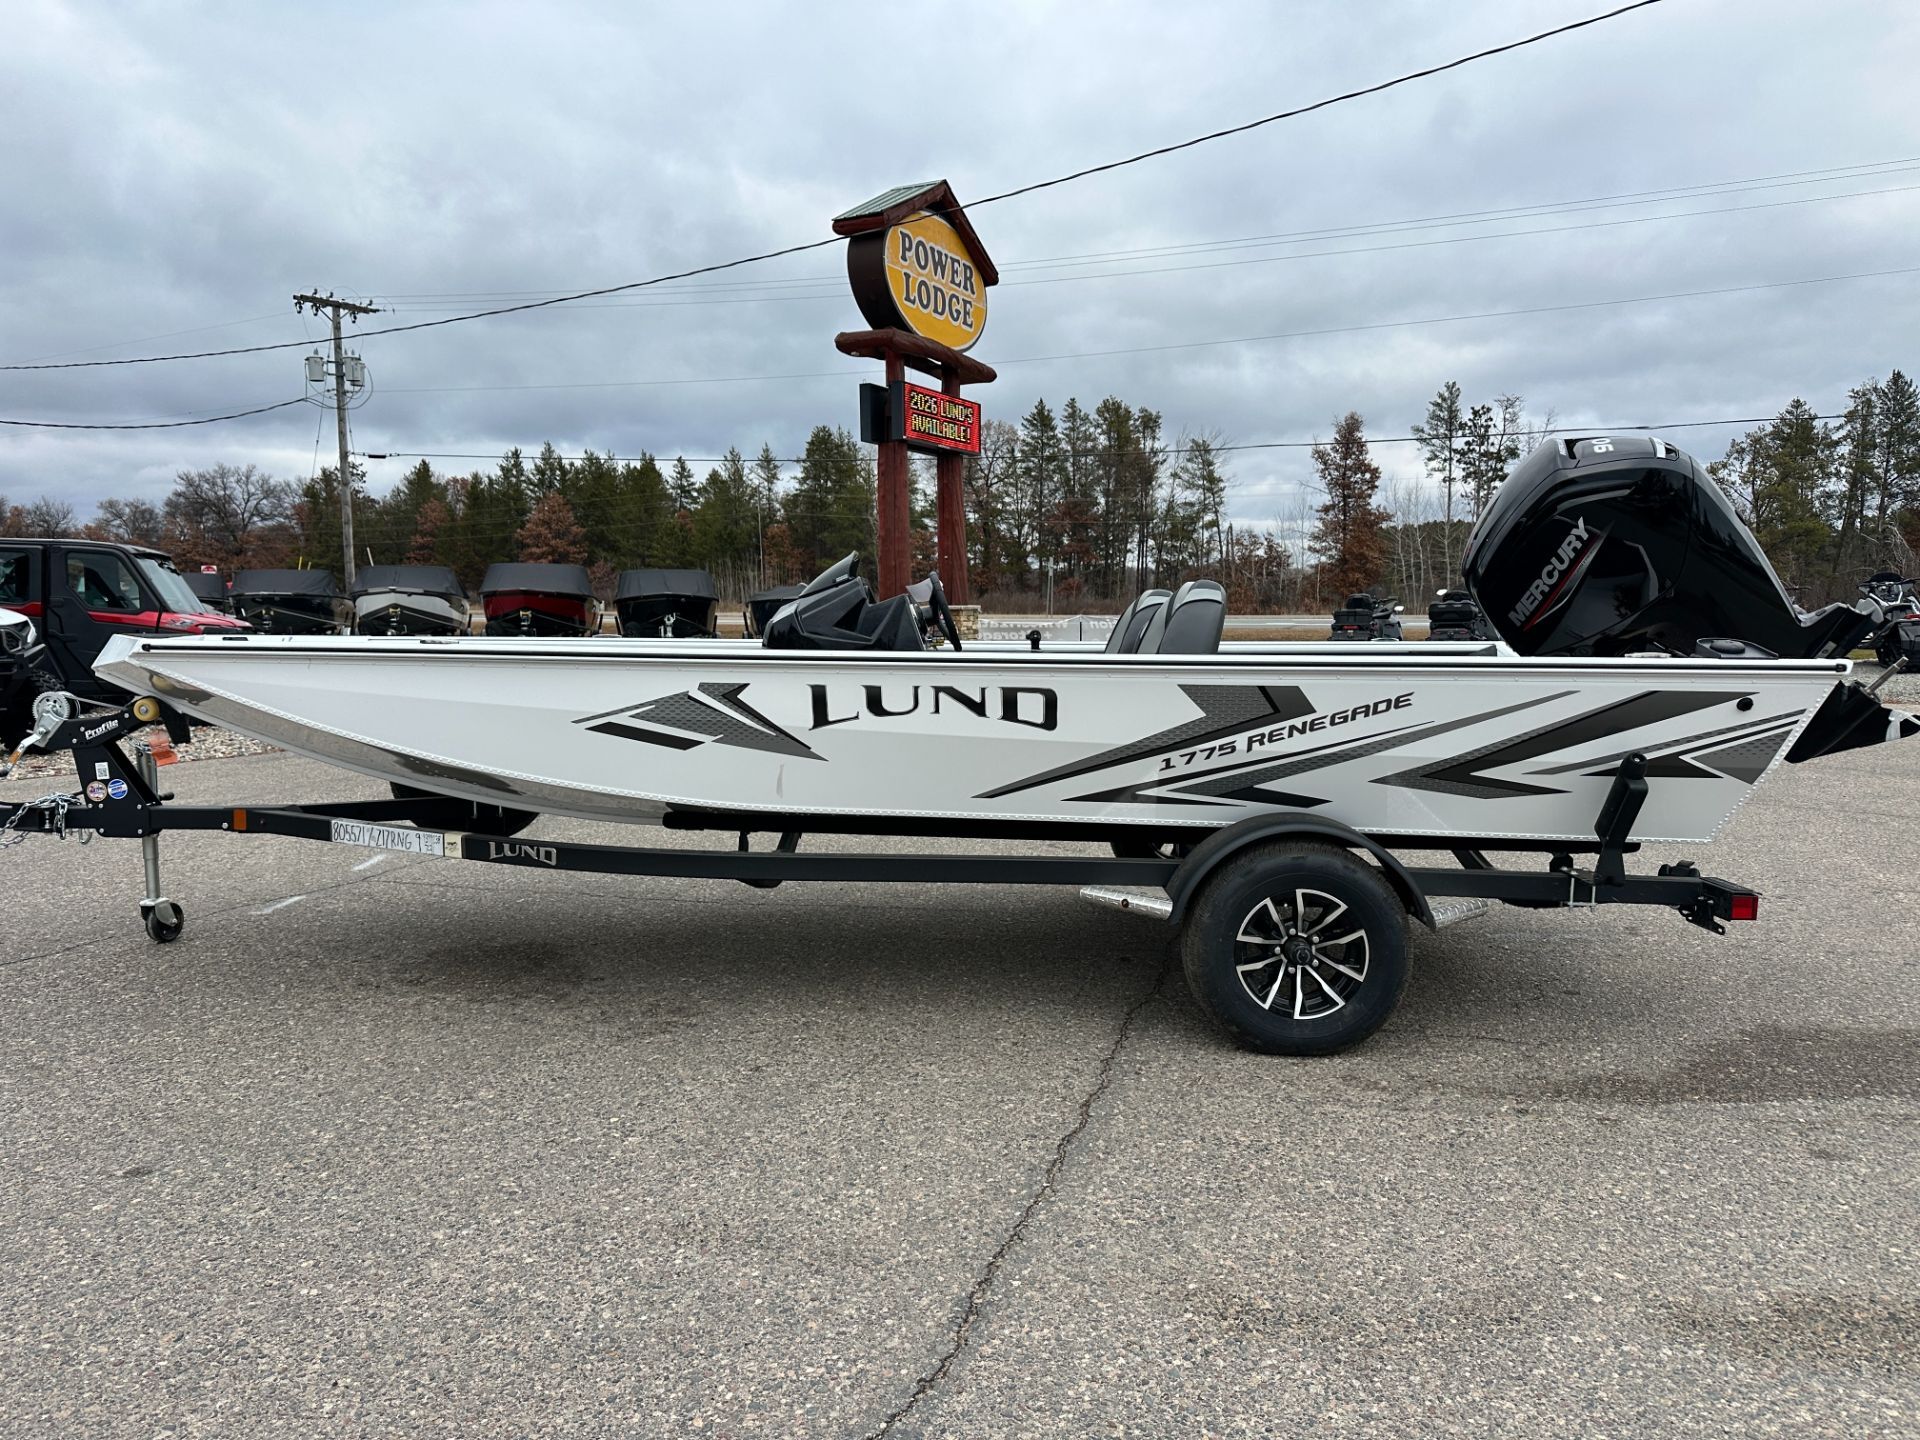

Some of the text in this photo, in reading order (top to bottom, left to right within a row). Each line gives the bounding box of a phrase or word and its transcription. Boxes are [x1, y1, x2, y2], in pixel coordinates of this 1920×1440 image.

[899, 230, 976, 295] POWER
[903, 272, 974, 329] LODGE
[910, 391, 973, 424] 2026 LUND'S
[911, 413, 970, 443] AVAILABLE!
[1508, 516, 1589, 627] MERCURY
[84, 719, 119, 740] Profile
[806, 683, 1058, 731] LUND
[1158, 691, 1415, 771] 1775 RENEGADE
[488, 841, 557, 866] LUND
